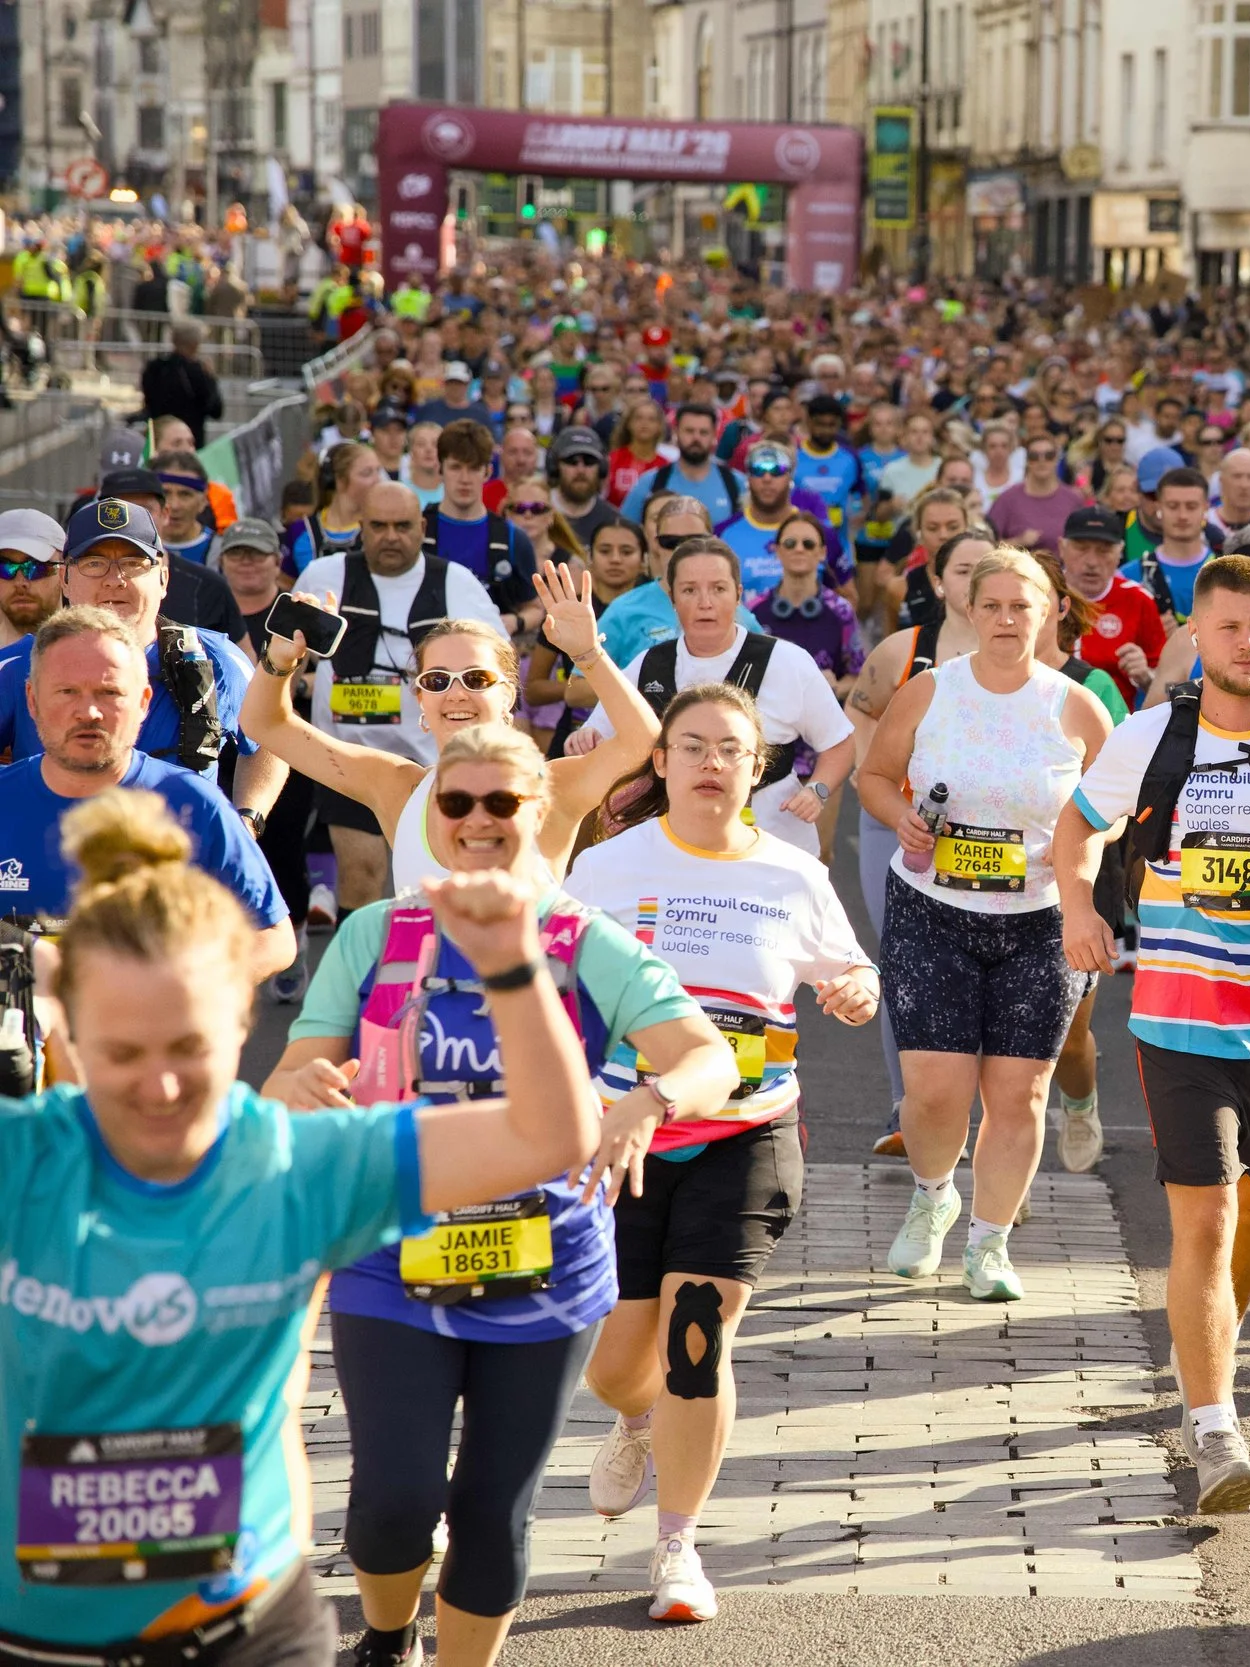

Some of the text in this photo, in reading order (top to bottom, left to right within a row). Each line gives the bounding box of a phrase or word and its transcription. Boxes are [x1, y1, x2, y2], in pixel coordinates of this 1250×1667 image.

[343, 686, 384, 698] PARMY
[349, 699, 378, 710] 9678
[1187, 771, 1250, 785] ymchwil
[1185, 788, 1234, 801] cymru
[1185, 803, 1234, 815] cancer
[1186, 818, 1230, 831] wales
[966, 827, 990, 837] CARDIFF
[990, 830, 1006, 838] HALF
[1220, 835, 1250, 844] CARDIFF
[953, 842, 1003, 860] KAREN
[954, 857, 1001, 873] 27645
[665, 908, 718, 924] cymru
[666, 896, 792, 921] ymchwil canser
[663, 924, 718, 940] cancer
[661, 939, 710, 956] wales
[724, 1014, 744, 1024] HALF
[453, 1201, 522, 1216] CARDIFF HALF
[440, 1227, 513, 1251] JAMIE
[441, 1249, 512, 1274] 18631
[51, 1463, 221, 1508] REBECCA
[75, 1501, 196, 1543] 20065
